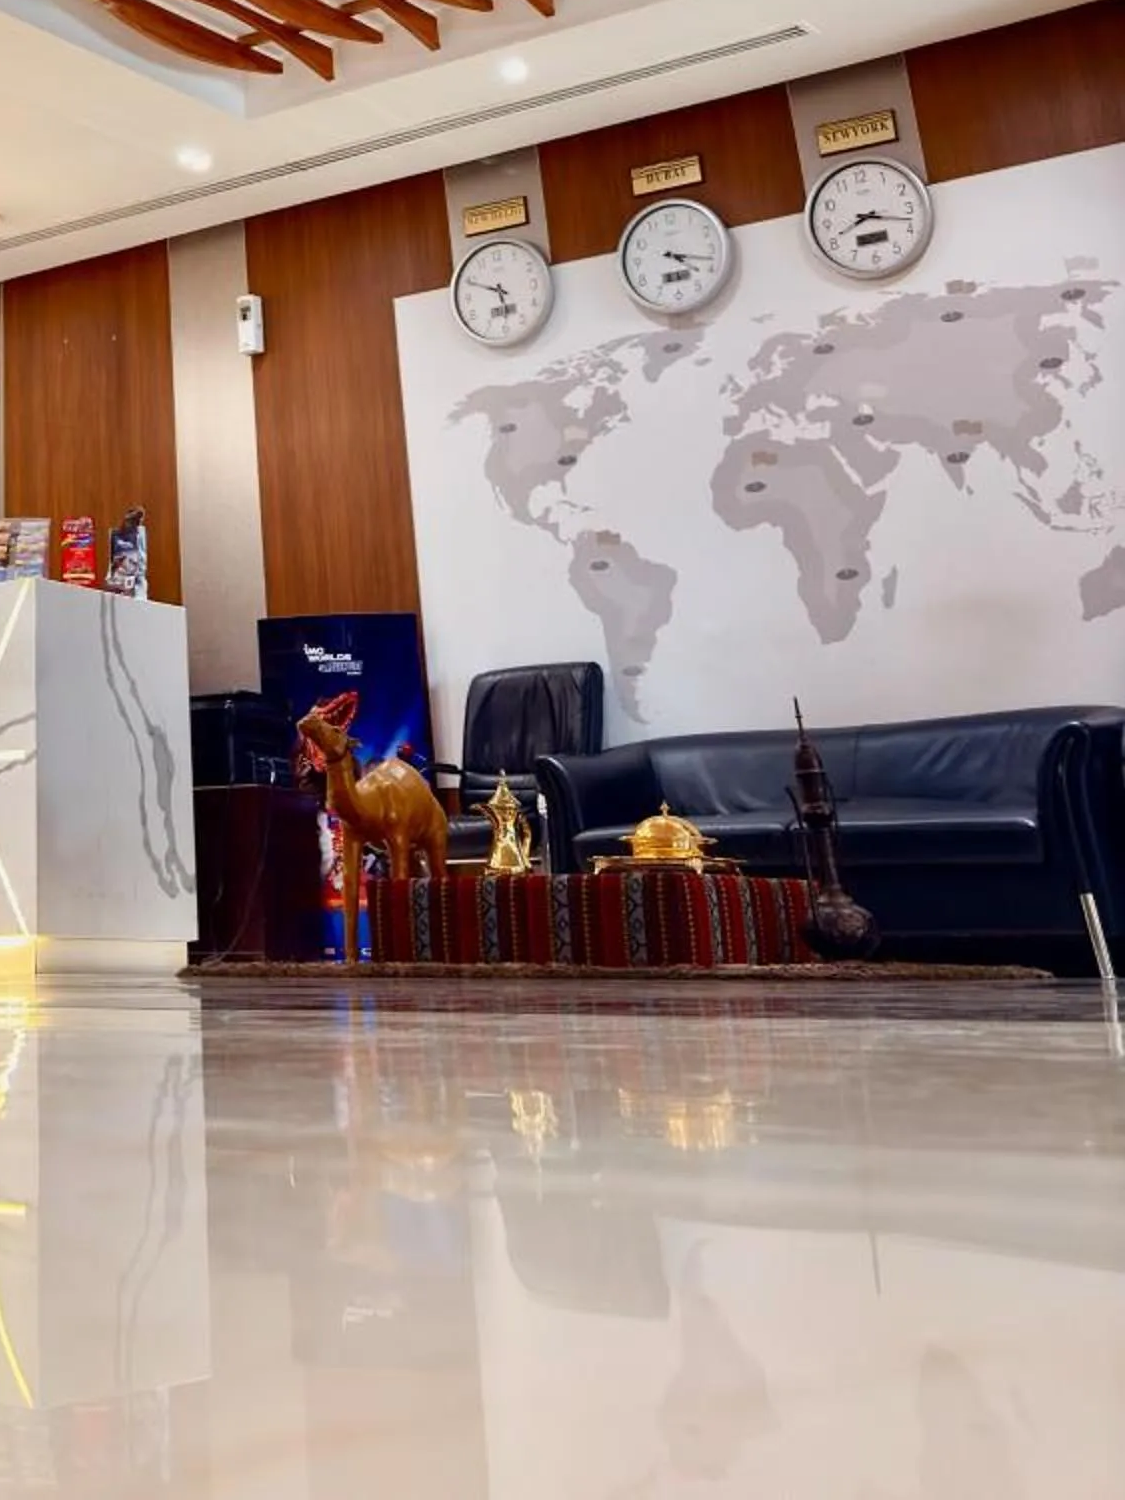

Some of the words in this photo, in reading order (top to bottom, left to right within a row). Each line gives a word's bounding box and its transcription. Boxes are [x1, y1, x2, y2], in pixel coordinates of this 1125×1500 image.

[825, 119, 890, 144] NEWYORK
[853, 169, 867, 184] 12
[835, 180, 849, 193] 11
[897, 183, 907, 197] 2
[824, 199, 836, 212] 10
[906, 202, 914, 215] 3
[906, 221, 914, 235] 4
[830, 238, 840, 251] 8
[892, 241, 902, 255] 5
[872, 252, 881, 266] 6
